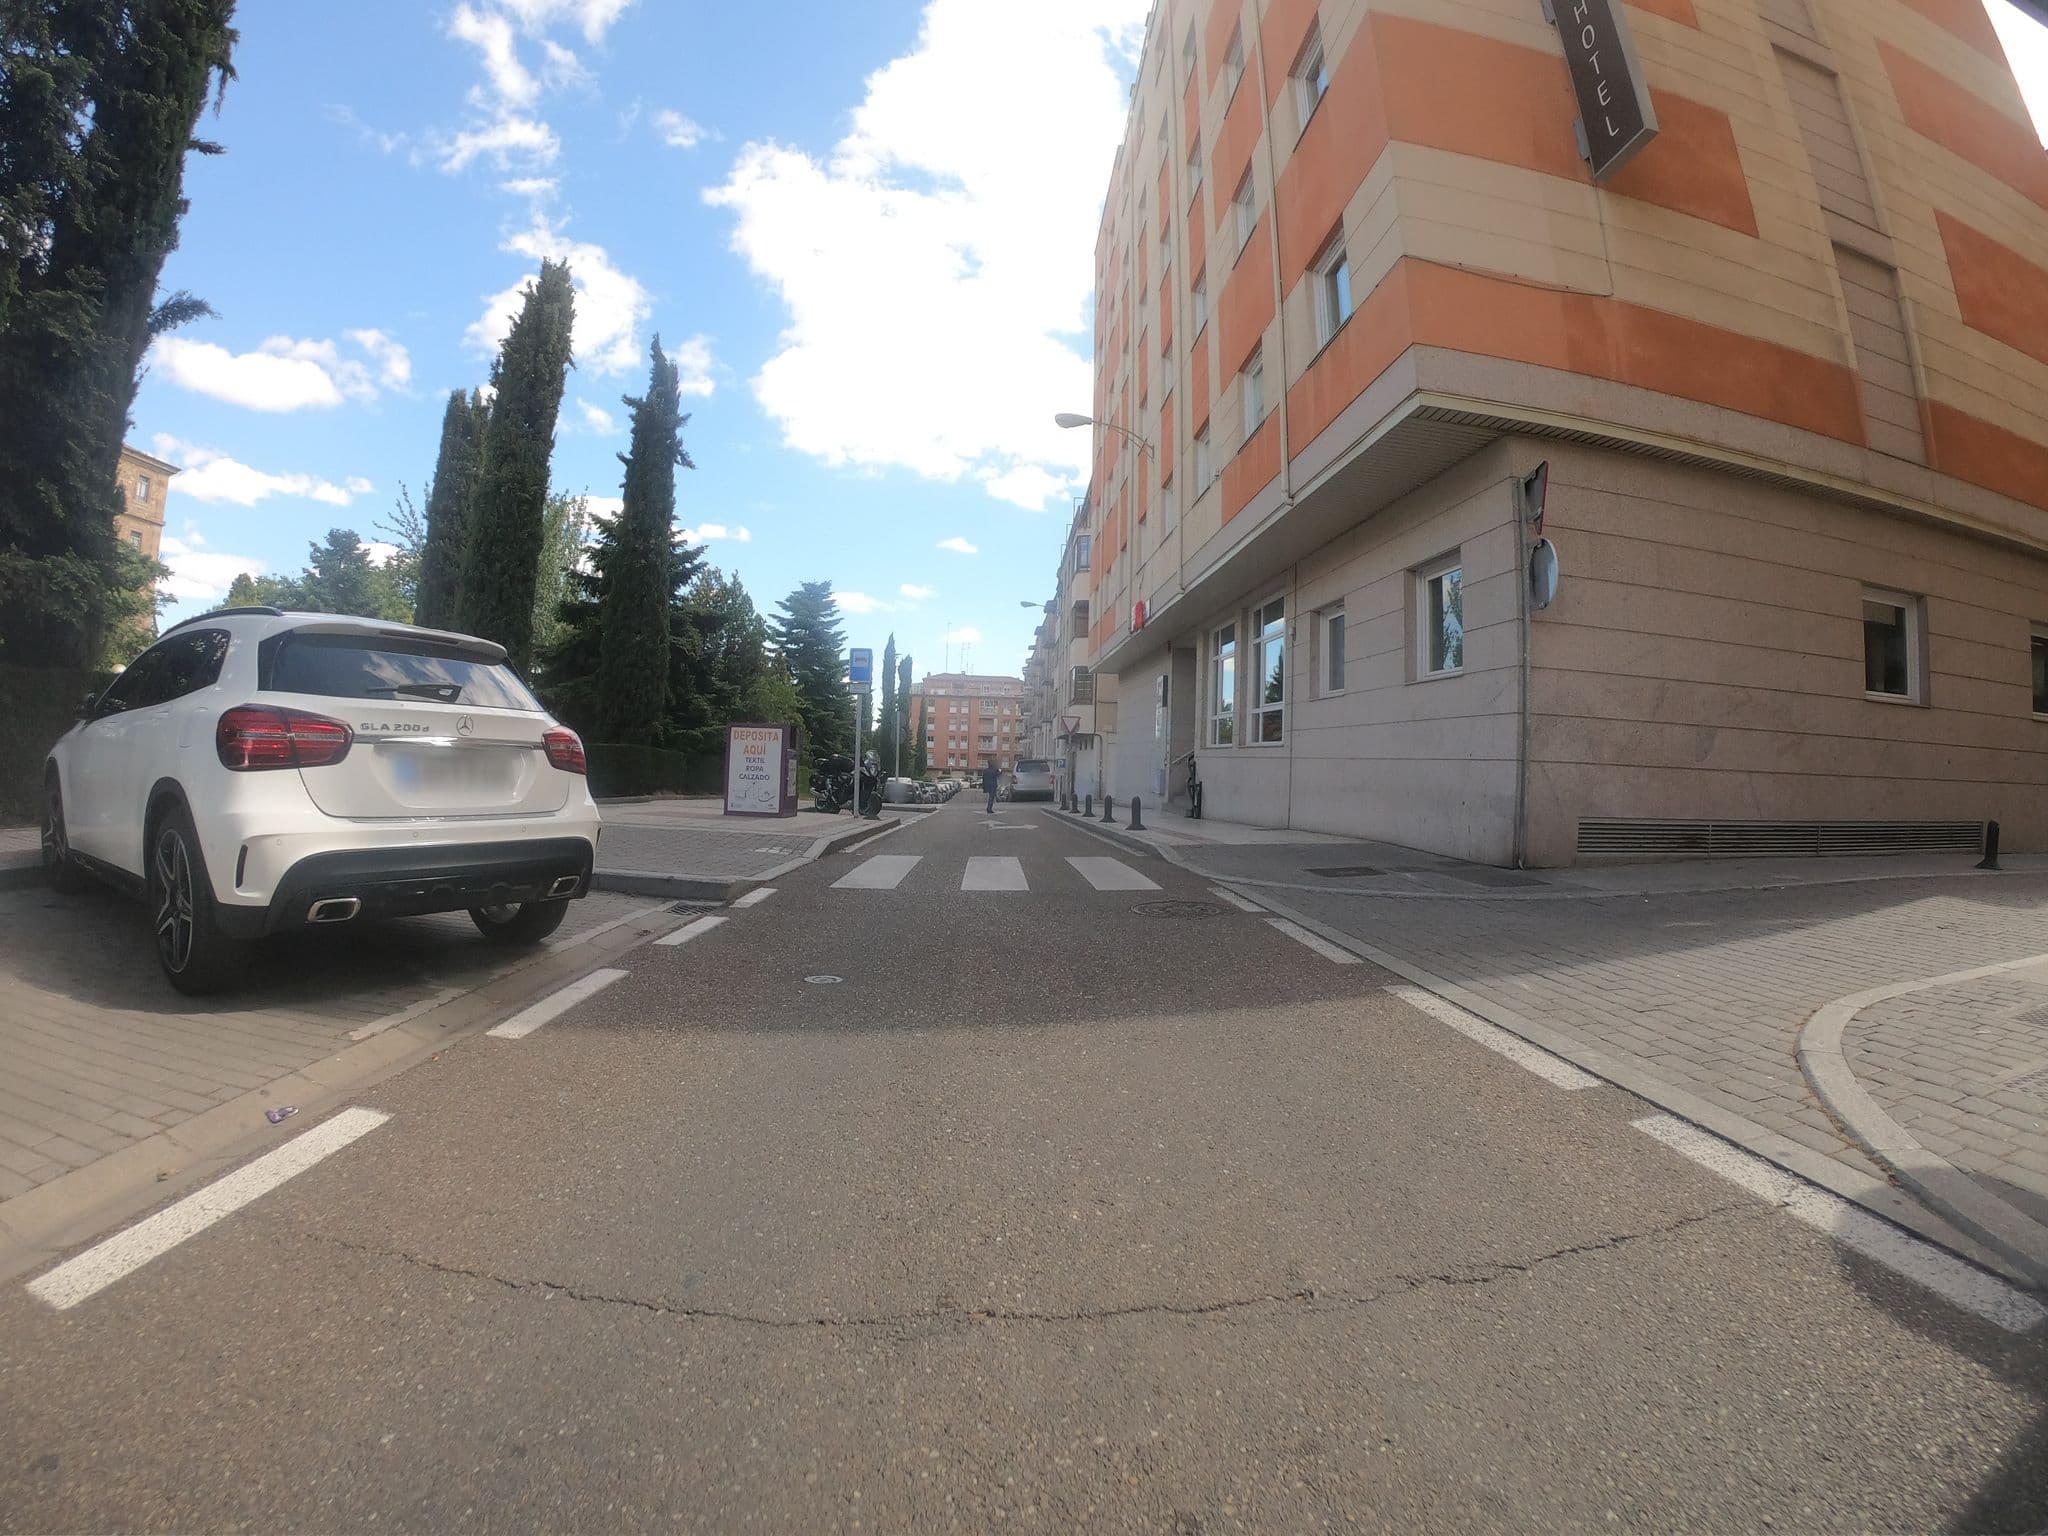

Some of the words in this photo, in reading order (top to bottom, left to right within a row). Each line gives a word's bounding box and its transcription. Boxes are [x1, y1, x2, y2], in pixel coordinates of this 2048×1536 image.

[1573, 0, 1620, 137] HOTEL
[361, 722, 390, 731] GLA
[733, 731, 778, 741] DEPOSITA
[738, 773, 770, 781] CALZADO
